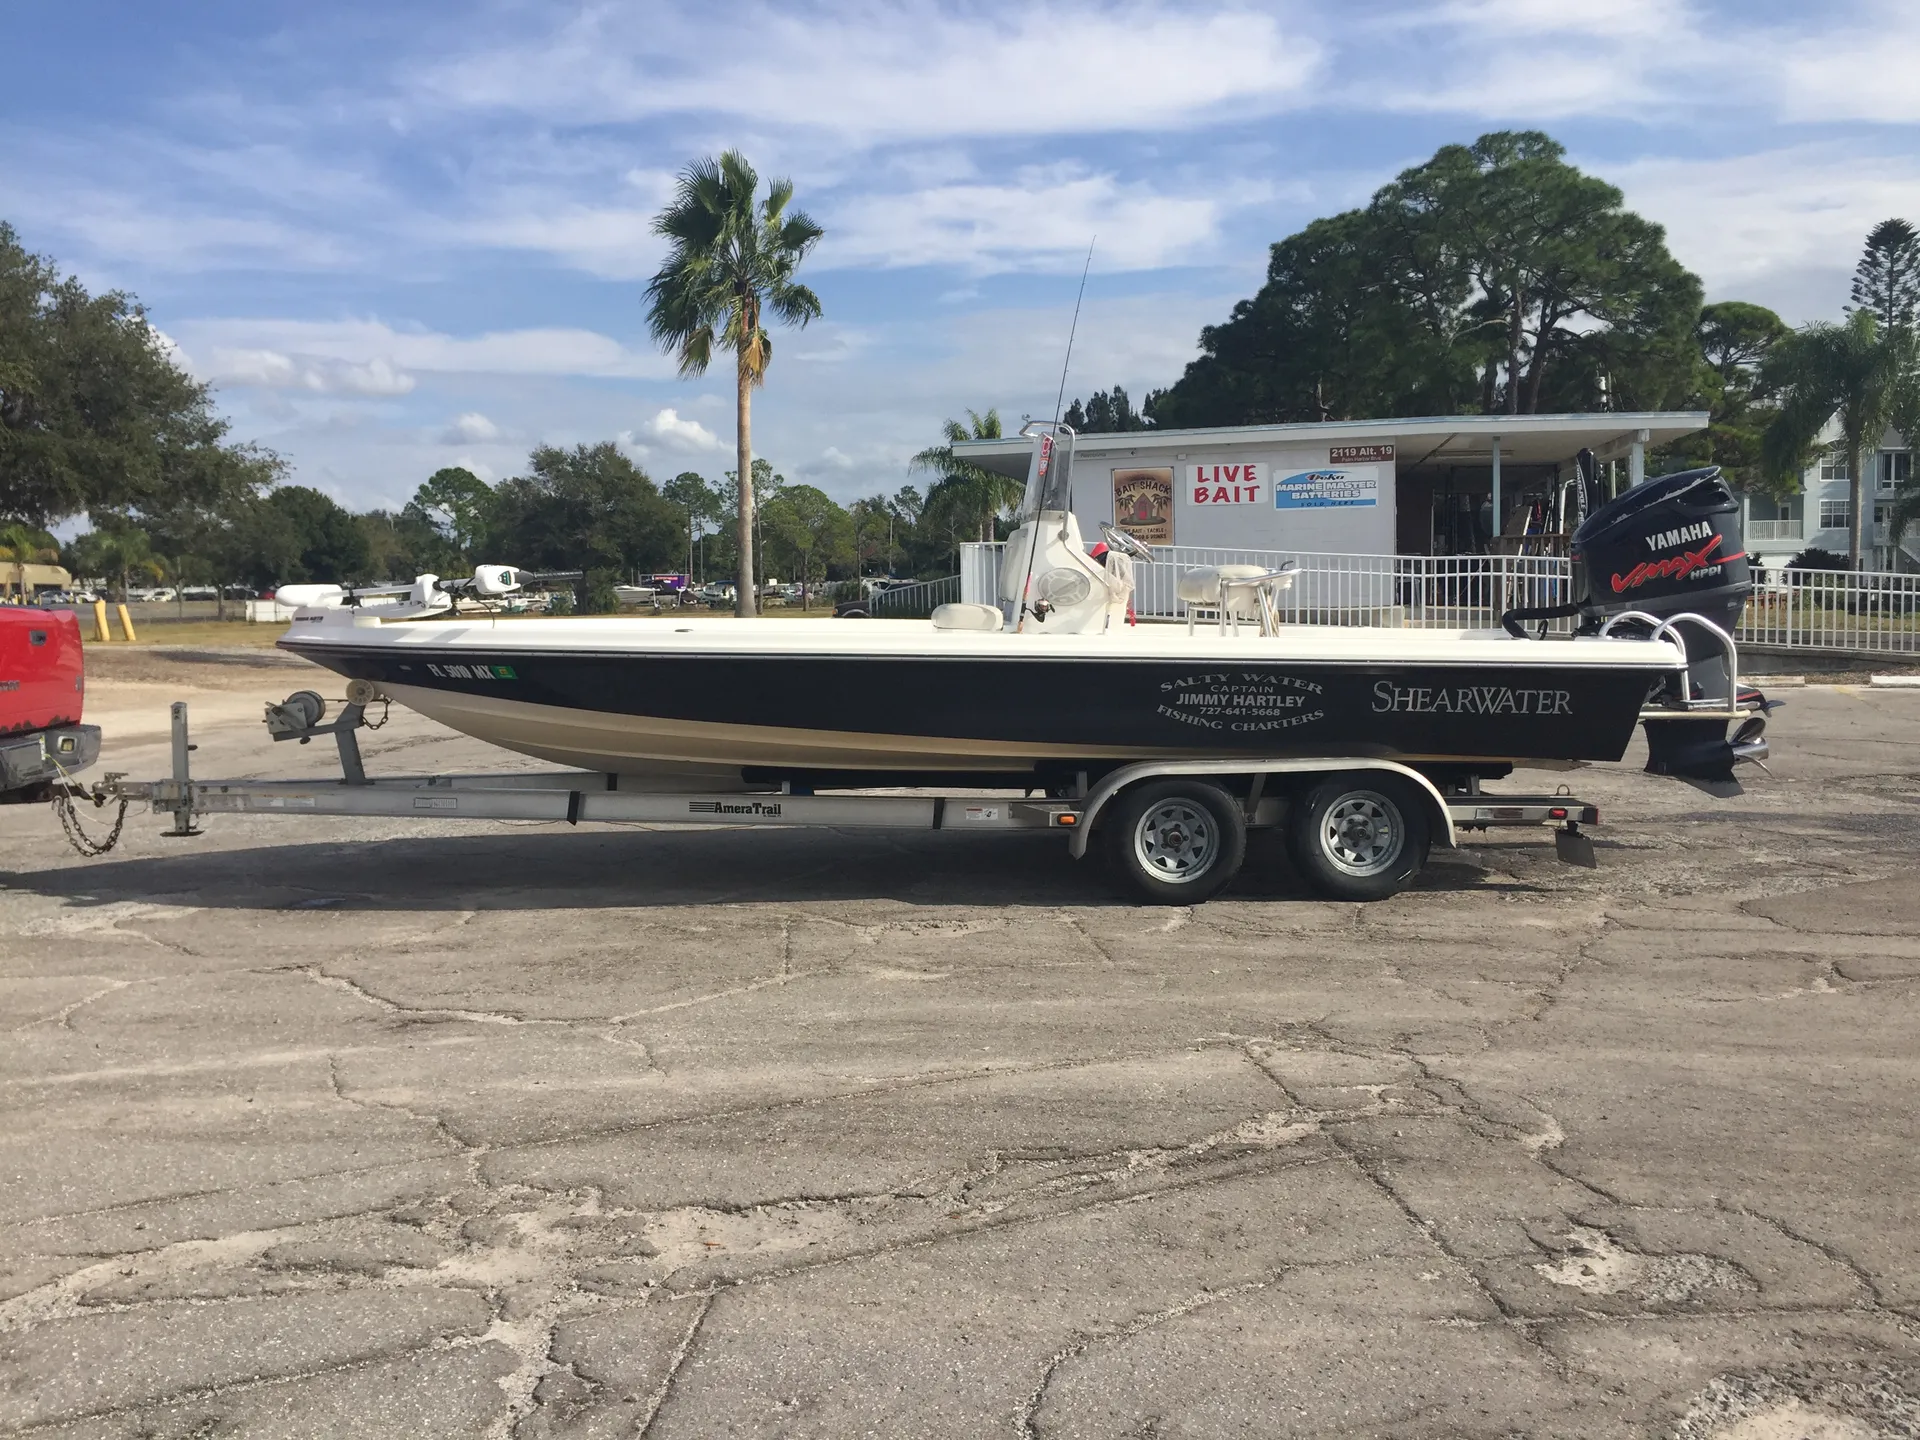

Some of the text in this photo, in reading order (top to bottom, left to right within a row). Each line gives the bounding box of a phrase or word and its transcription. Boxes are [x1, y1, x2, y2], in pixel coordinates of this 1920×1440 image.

[1331, 446, 1393, 457] 2119 Alt. 19
[1196, 464, 1257, 483] LIVE
[1115, 480, 1171, 496] BAIT SHACK
[1276, 480, 1377, 492] MARINE MASTER
[1194, 485, 1261, 504] BAIT
[1291, 490, 1361, 500] BATTERIES
[1645, 520, 1713, 552] YAMAHA
[1690, 564, 1722, 580] HPDI
[426, 664, 447, 677] FL
[471, 665, 496, 679] MX
[1160, 673, 1324, 695] SALTY WATER
[1210, 684, 1275, 693] CAPTAIN
[1175, 693, 1306, 708] JIMMY HARTLEY
[1156, 704, 1325, 732] FISHING CHARTERS
[1199, 707, 1281, 717] 727-641-5668
[714, 802, 782, 814] AmeraTrail
